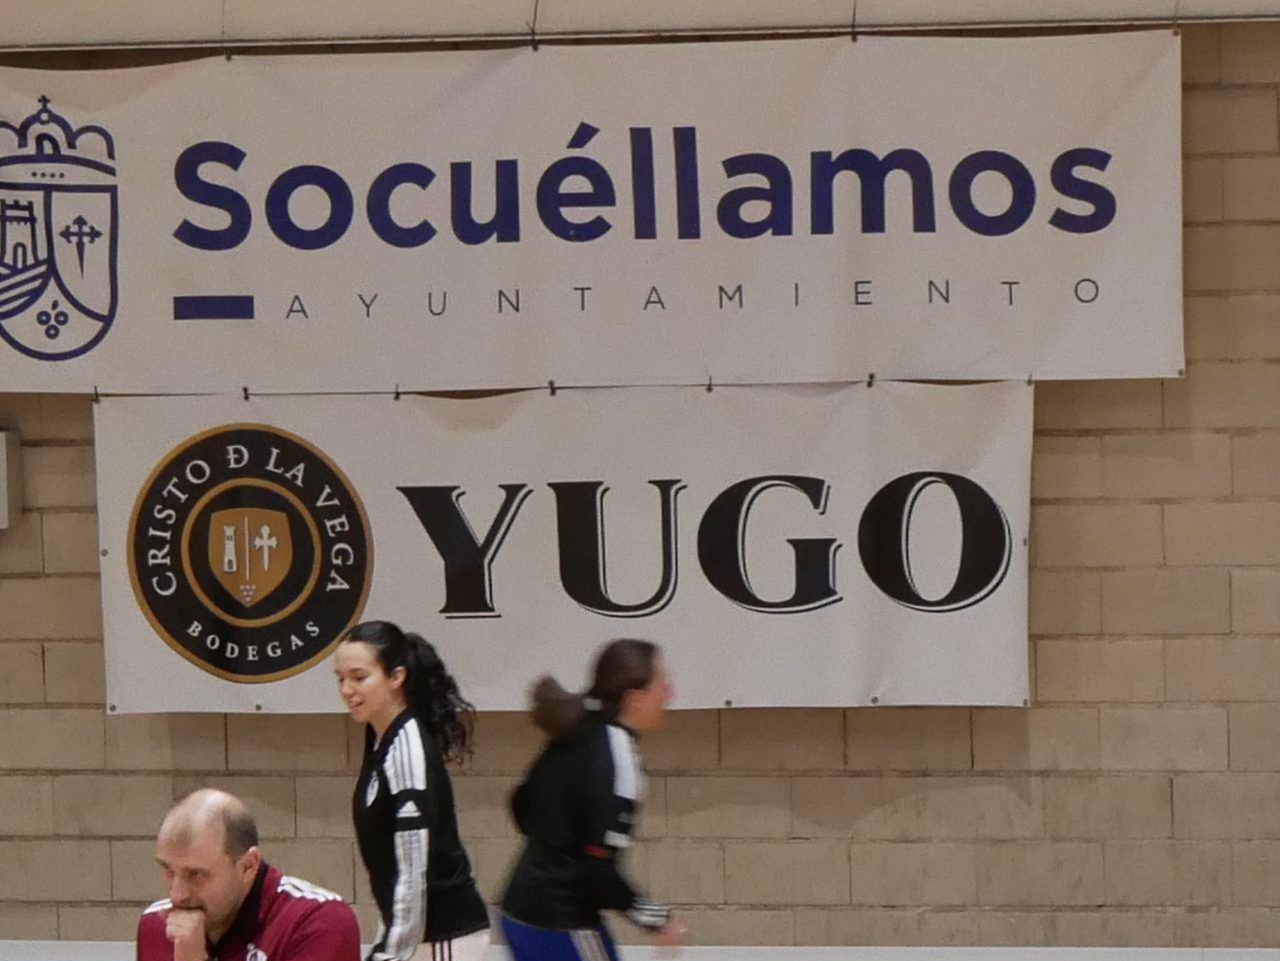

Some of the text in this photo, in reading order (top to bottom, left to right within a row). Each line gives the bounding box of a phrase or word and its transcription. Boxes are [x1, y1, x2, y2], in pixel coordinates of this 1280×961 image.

[173, 121, 1117, 252] Socuéllamos
[285, 277, 1101, 321] AYUNTAMIENTO
[147, 458, 211, 597] CRISTO
[264, 446, 306, 488] LA
[314, 484, 355, 593] VEGA
[395, 470, 1014, 620] YUGO
[186, 620, 321, 662] BODEGAS
